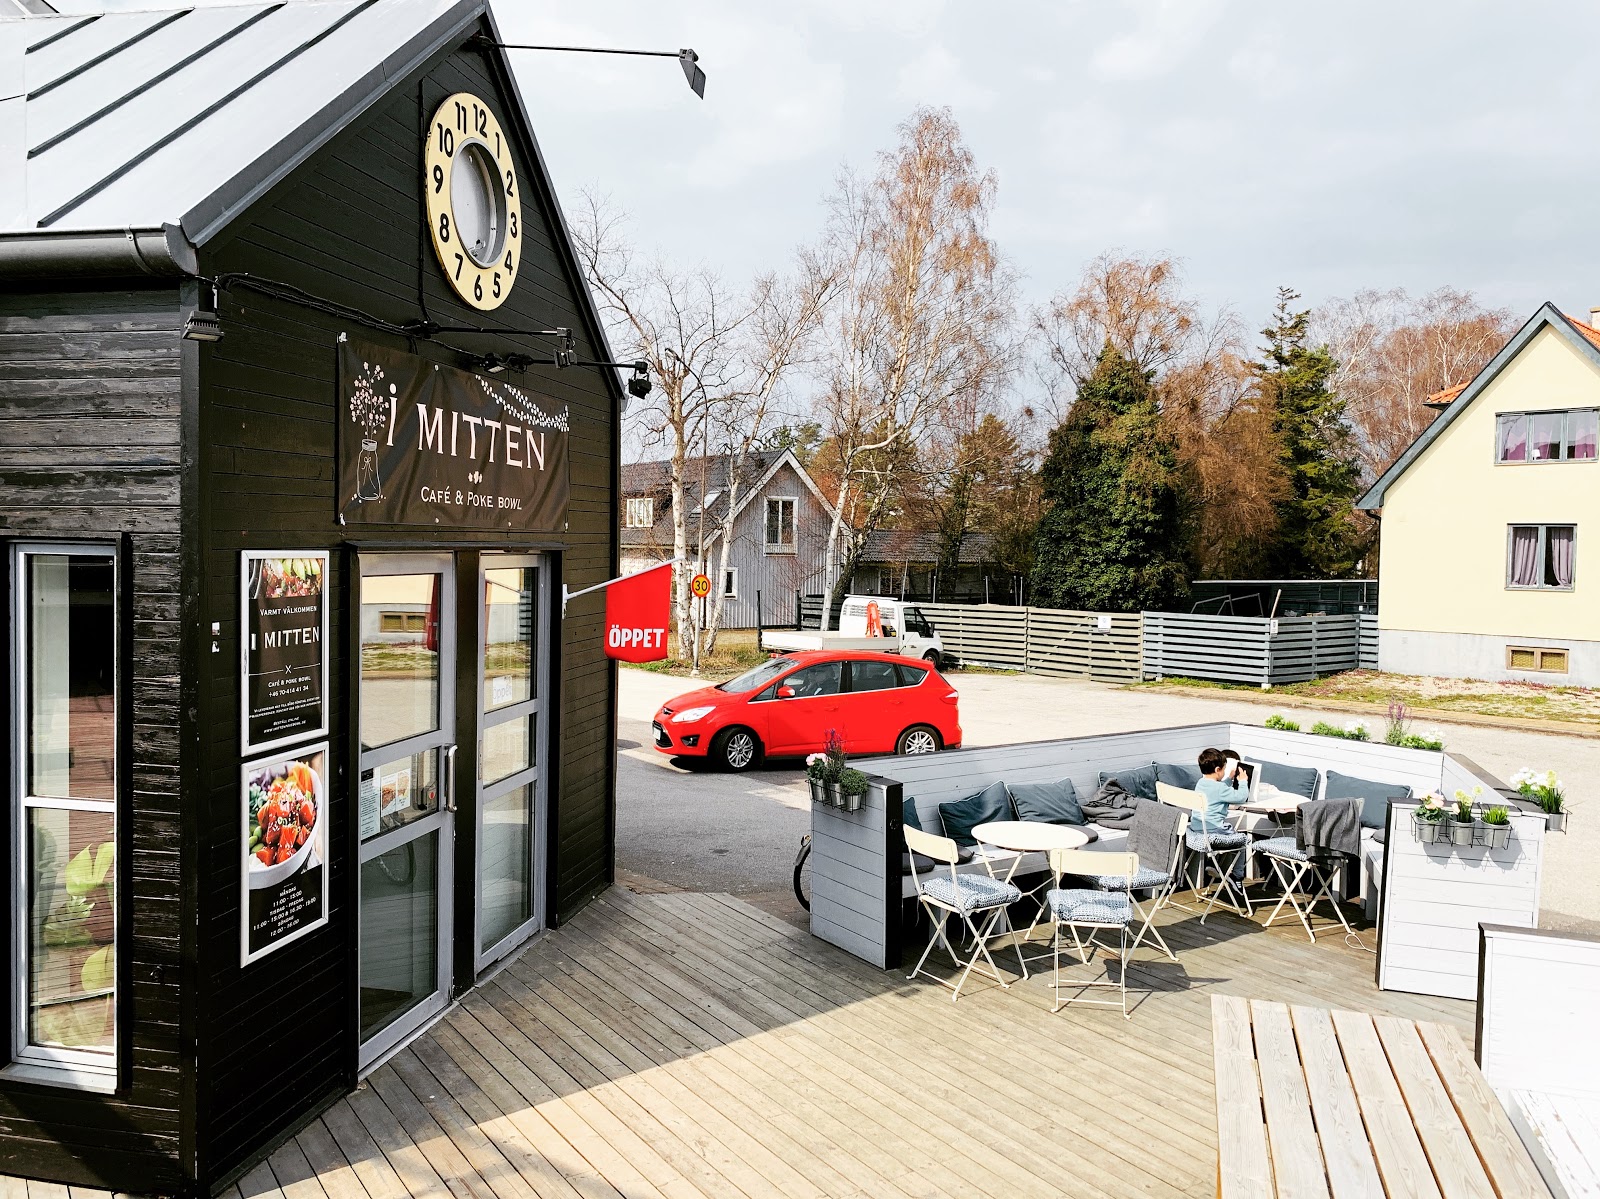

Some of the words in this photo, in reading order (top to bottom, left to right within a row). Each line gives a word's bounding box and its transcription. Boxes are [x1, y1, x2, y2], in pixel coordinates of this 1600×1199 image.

[455, 101, 467, 134] 11
[473, 103, 487, 138] 12
[438, 123, 454, 158] 10
[496, 132, 500, 159] 1
[433, 164, 443, 194] 9
[506, 170, 514, 197] 2
[440, 213, 450, 243] 8
[510, 212, 518, 238] 3
[455, 253, 464, 281] 7
[505, 250, 513, 275] 4
[474, 275, 482, 301] 6
[493, 272, 500, 299] 5
[417, 403, 544, 471] MITTEN
[456, 490, 463, 505] &
[467, 492, 493, 508] POKE
[498, 497, 522, 510] BOWL
[695, 580, 707, 591] 30
[283, 606, 317, 614] VÄLKOMMEN
[251, 634, 256, 650] I
[265, 626, 319, 648] MITTEN
[609, 624, 664, 648] ÖPPET
